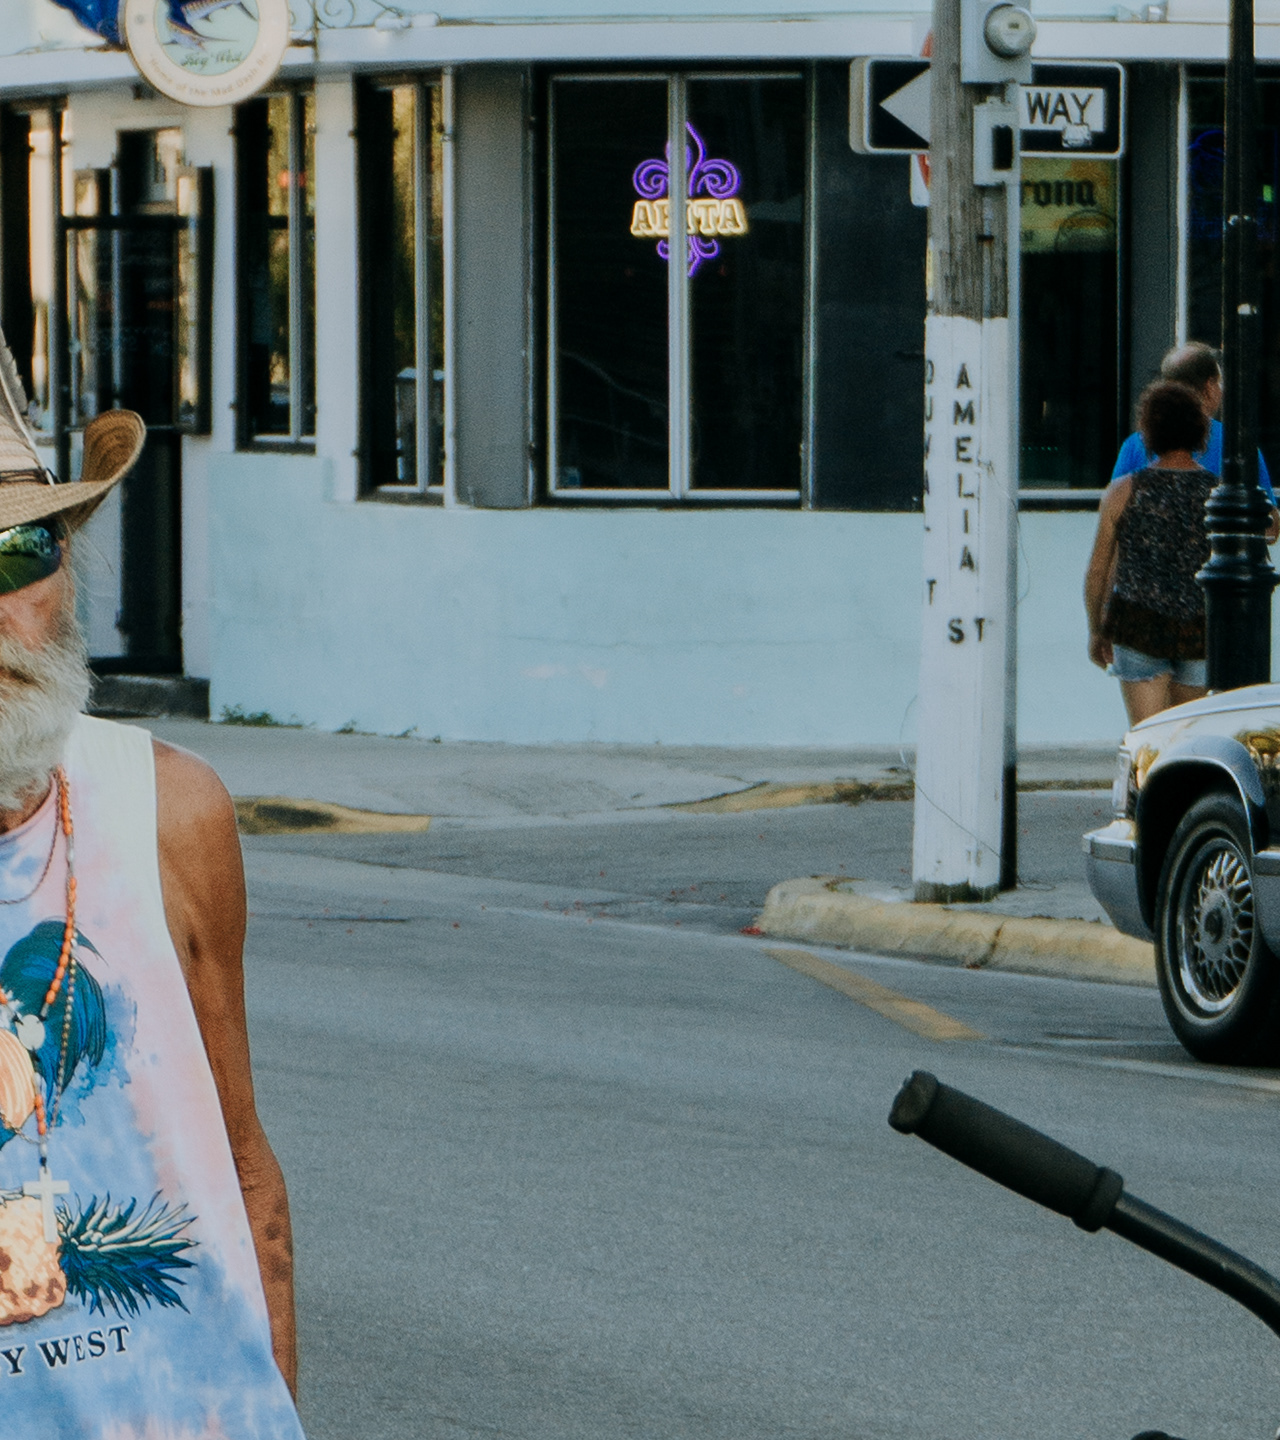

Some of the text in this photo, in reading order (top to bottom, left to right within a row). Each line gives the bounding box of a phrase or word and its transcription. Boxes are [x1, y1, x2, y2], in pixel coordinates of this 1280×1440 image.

[1026, 91, 1094, 125] WAY
[948, 363, 985, 644] AMELIA ST
[38, 1325, 131, 1367] WEST
